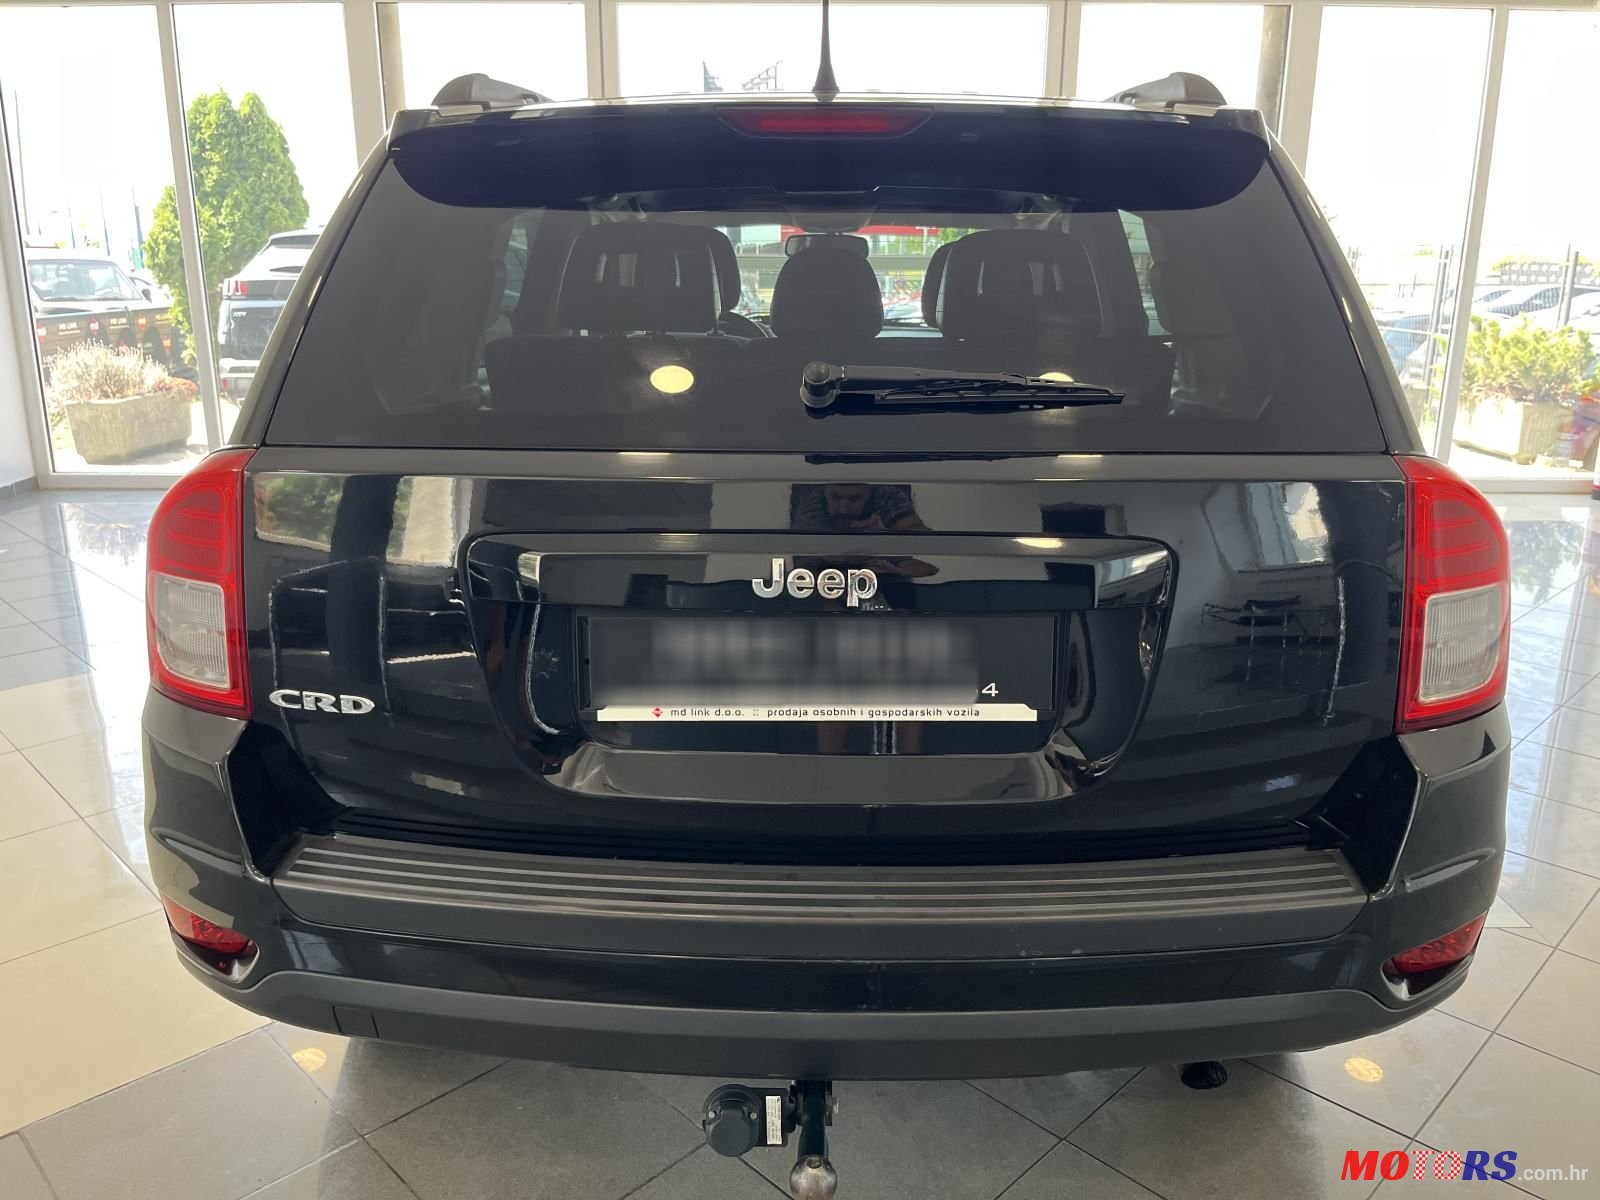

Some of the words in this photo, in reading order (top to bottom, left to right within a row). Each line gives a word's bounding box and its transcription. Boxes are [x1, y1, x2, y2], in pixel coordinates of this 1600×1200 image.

[751, 557, 878, 607] Jeep
[268, 688, 376, 714] CRD
[670, 707, 687, 717] md
[691, 707, 710, 717] link
[714, 707, 745, 717] d.o.o.
[767, 707, 808, 719] prodaja
[812, 707, 856, 717] osobnih
[867, 707, 942, 719] gospodarskih
[946, 707, 980, 717] vozila
